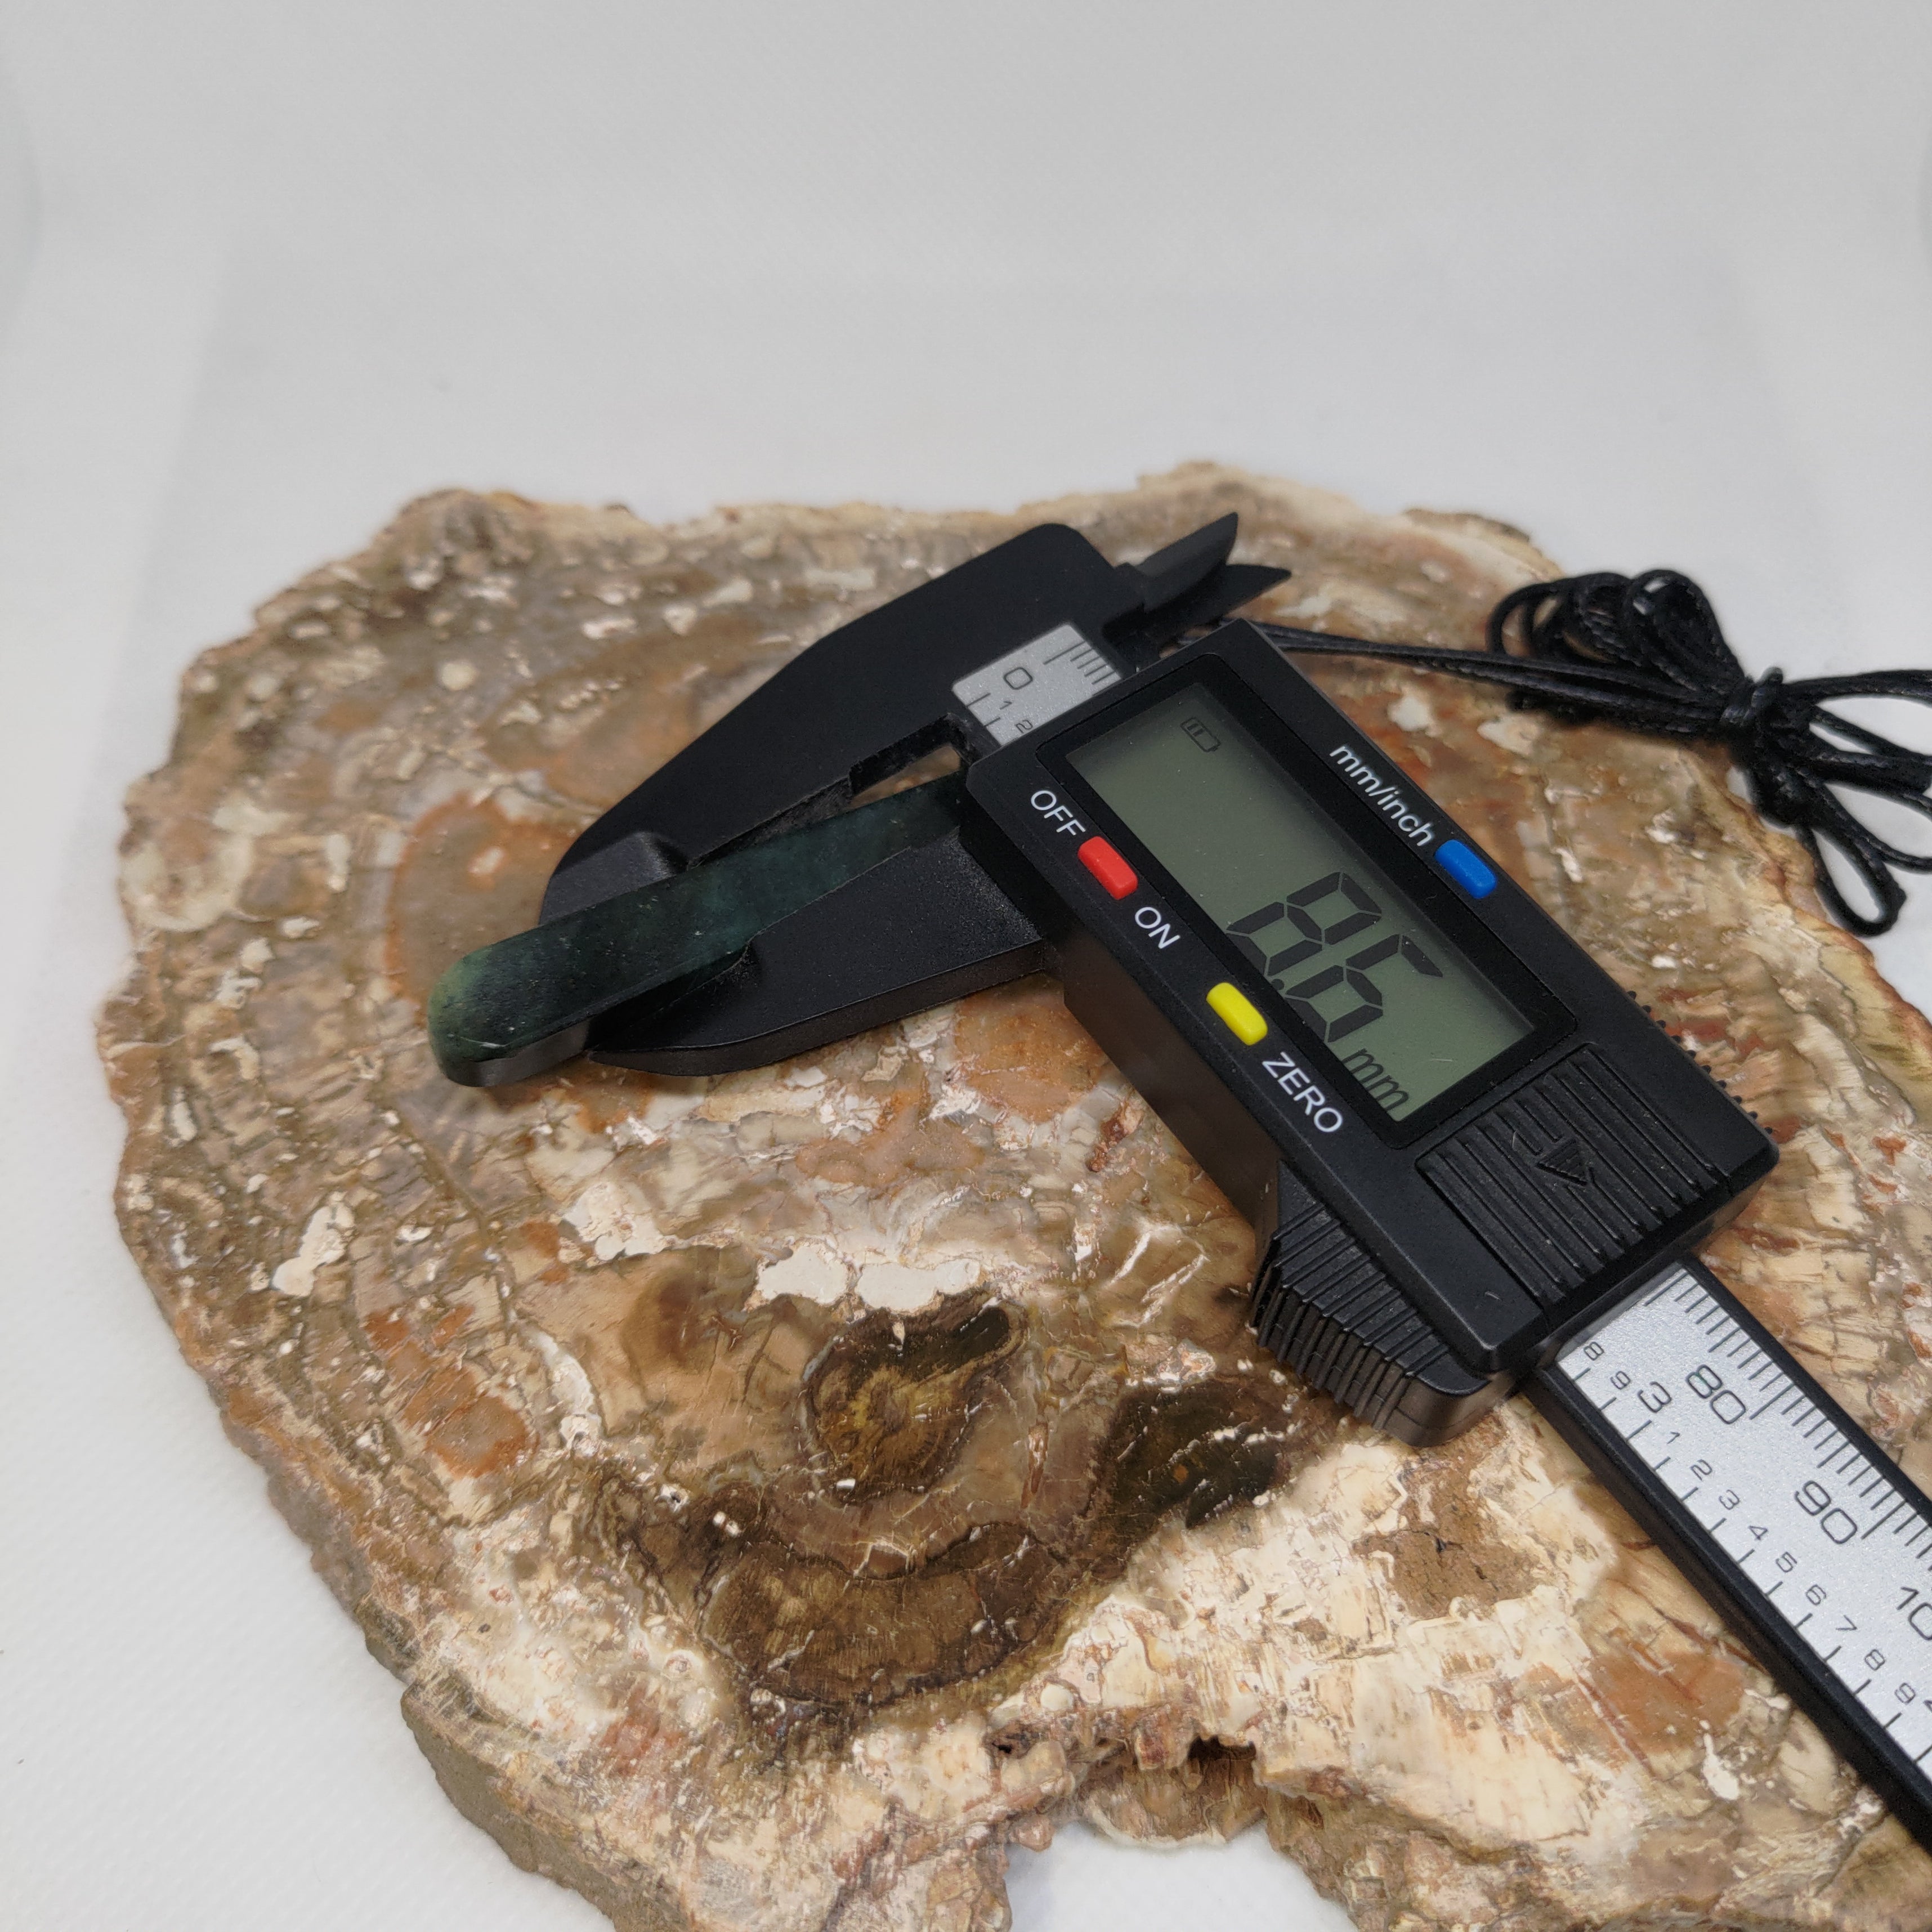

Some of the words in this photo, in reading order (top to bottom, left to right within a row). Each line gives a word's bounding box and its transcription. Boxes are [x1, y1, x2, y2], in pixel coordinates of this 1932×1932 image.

[999, 700, 1013, 710] 1
[1016, 719, 1034, 734] 2
[1003, 667, 1034, 691] 0
[1030, 789, 1086, 839] OFF
[1329, 744, 1435, 848] mm/inch
[1134, 905, 1181, 950] ON
[1226, 871, 1443, 1044] 8.6
[1343, 1048, 1411, 1112] mm
[1261, 1052, 1344, 1134] ZERO
[1685, 1364, 1747, 1425] 80
[1794, 1480, 1858, 1545] 90
[1583, 1341, 1605, 1361] 8
[1610, 1370, 1631, 1390] 9
[1637, 1380, 1672, 1414] 3
[1666, 1430, 1681, 1445] 1
[1690, 1459, 1713, 1481] 2
[1718, 1489, 1741, 1510] 3
[1748, 1524, 1769, 1541] 4
[1776, 1551, 1797, 1573] 5
[1805, 1584, 1827, 1606] 6
[1836, 1614, 1858, 1633] 7
[1864, 1649, 1886, 1671] 8
[1894, 1682, 1916, 1705] 9
